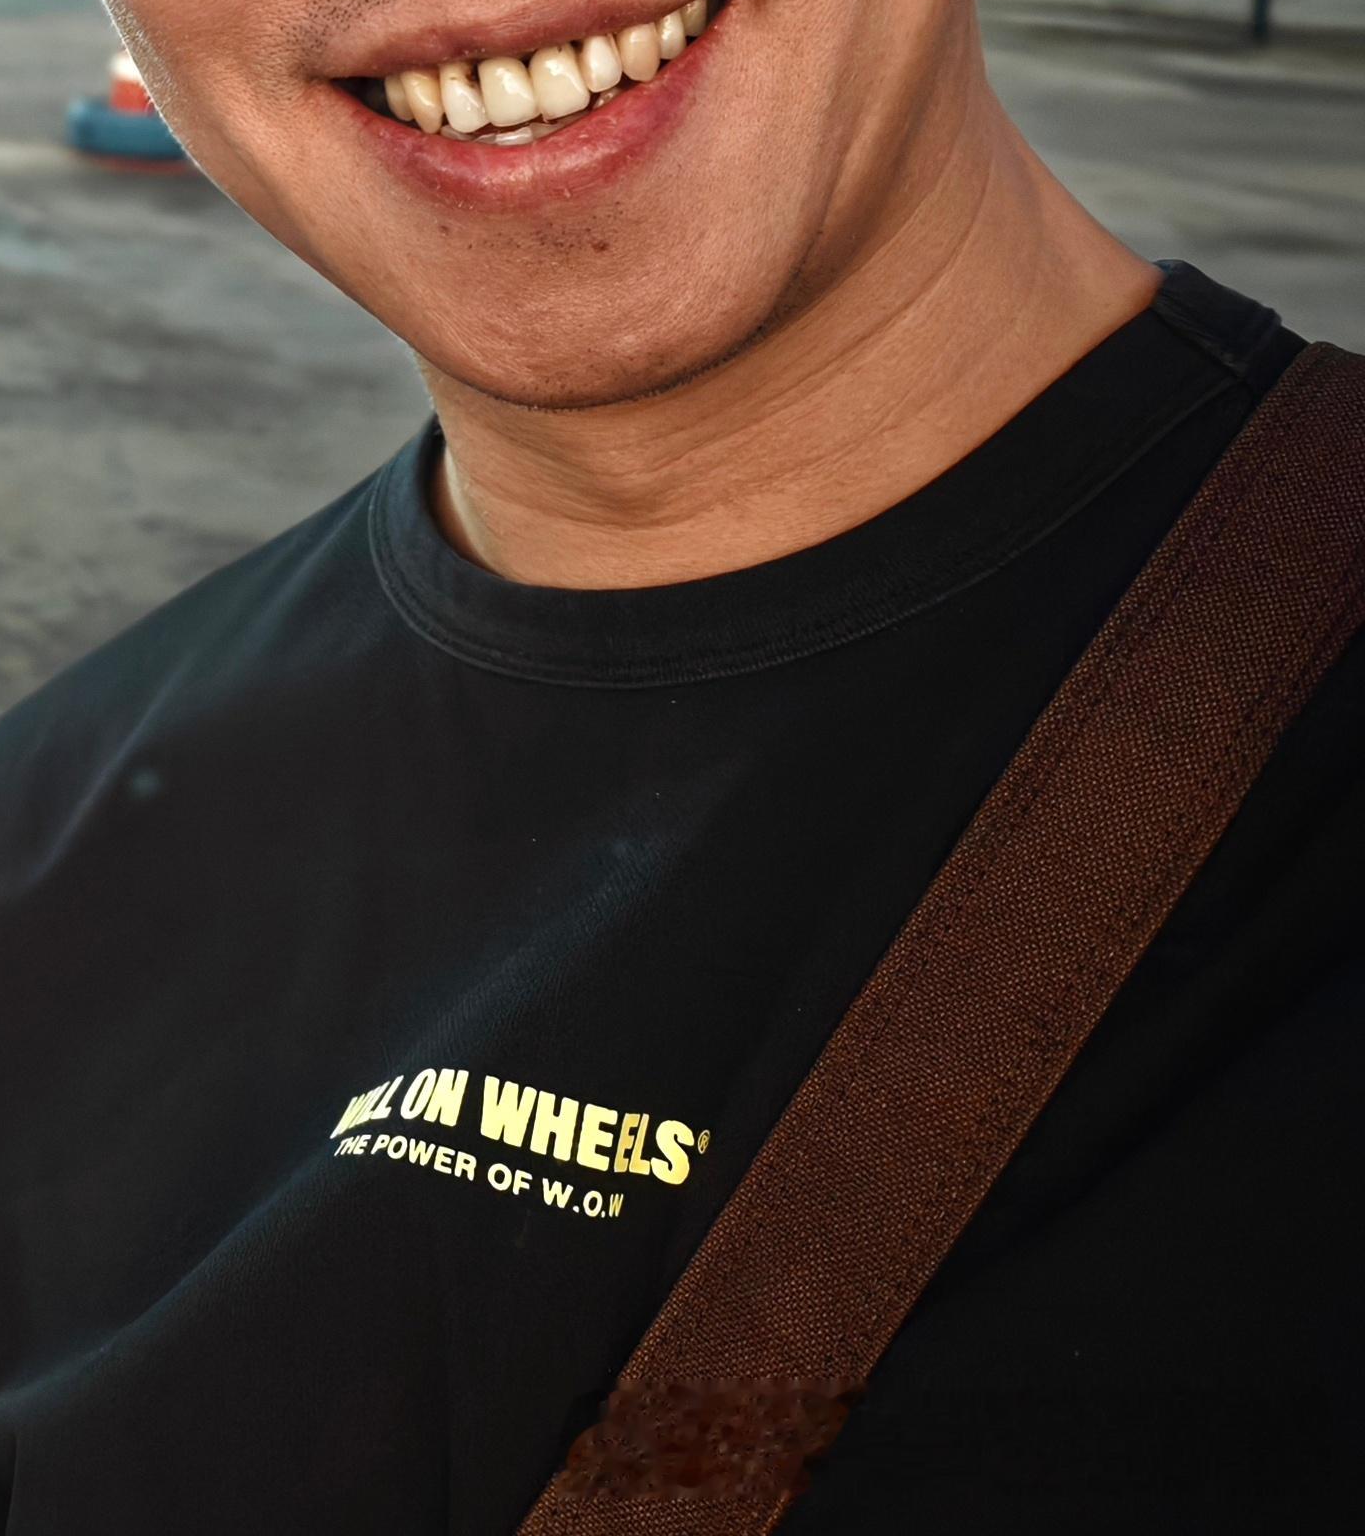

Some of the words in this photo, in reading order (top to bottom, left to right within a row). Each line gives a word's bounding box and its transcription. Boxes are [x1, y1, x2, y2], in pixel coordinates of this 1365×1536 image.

[399, 1067, 470, 1128] ON
[333, 1133, 373, 1157] THE
[370, 1133, 478, 1182] POWER
[487, 1162, 533, 1196] OF
